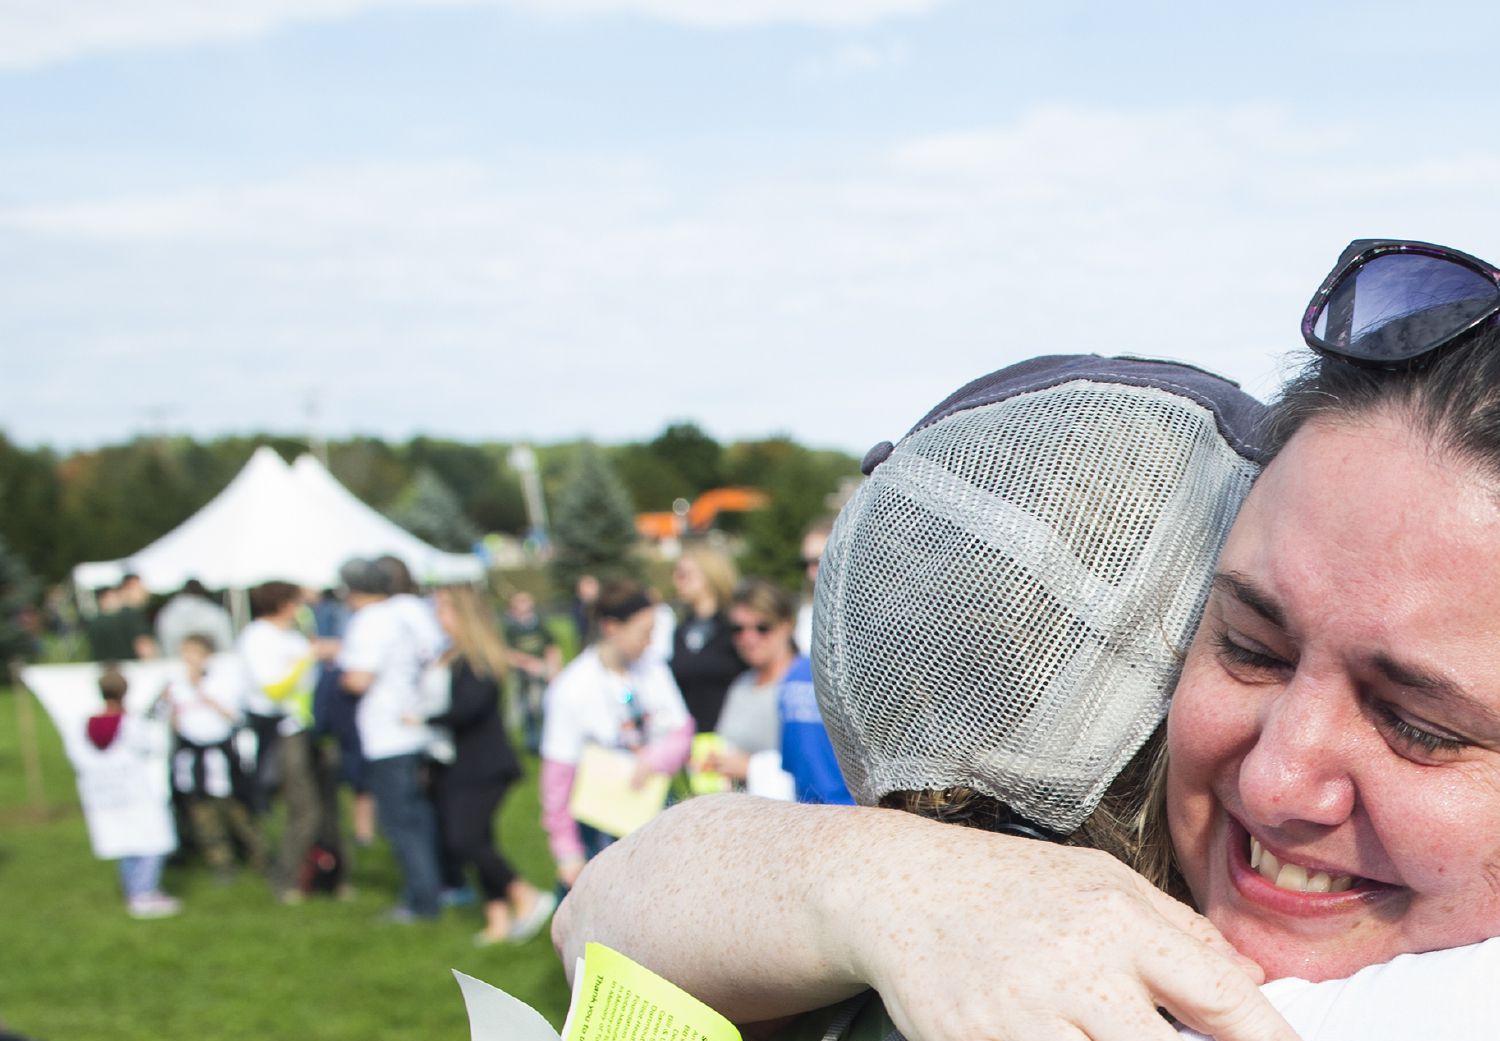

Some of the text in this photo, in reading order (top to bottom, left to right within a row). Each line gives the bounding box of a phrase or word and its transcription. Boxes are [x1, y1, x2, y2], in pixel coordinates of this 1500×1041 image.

[590, 975, 603, 1003] Thank
[584, 1005, 594, 1021] you
[581, 1023, 589, 1035] to
